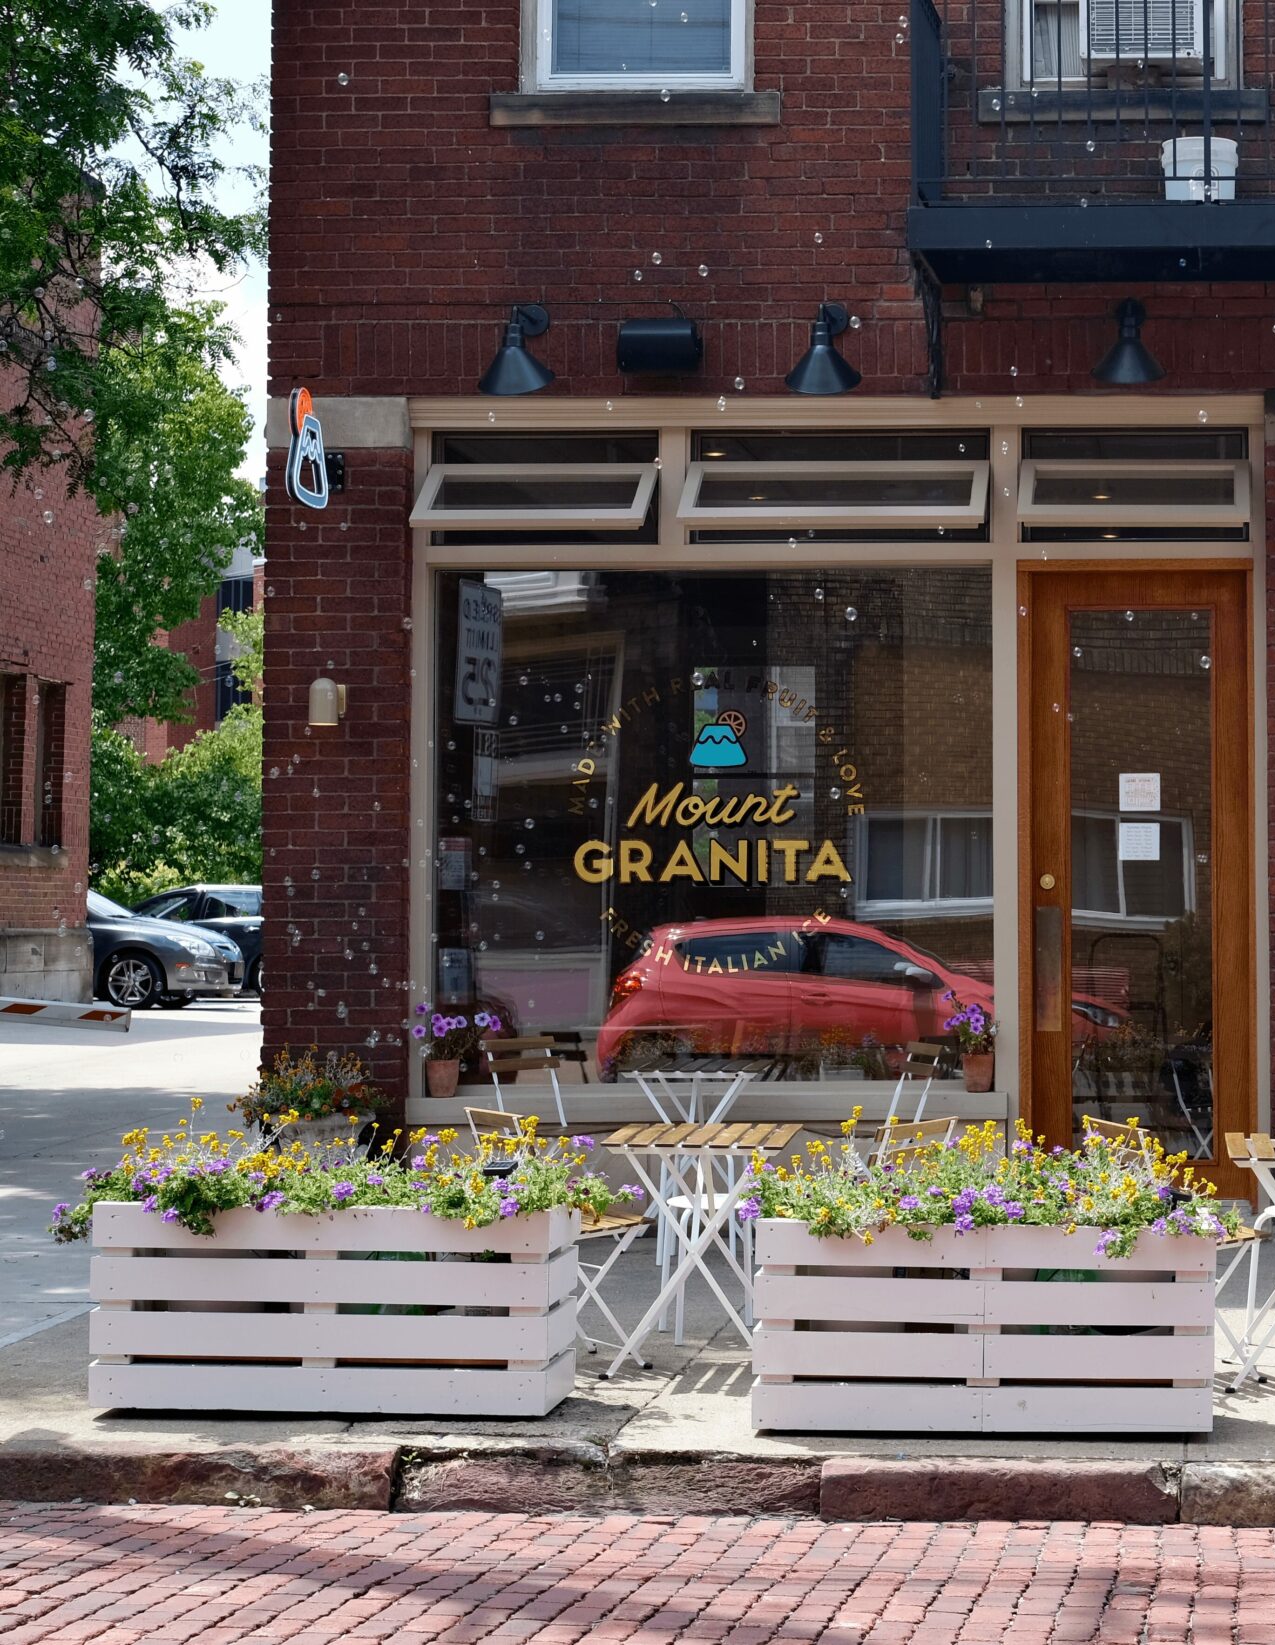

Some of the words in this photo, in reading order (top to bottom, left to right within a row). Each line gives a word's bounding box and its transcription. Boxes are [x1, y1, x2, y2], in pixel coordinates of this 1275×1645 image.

[600, 687, 661, 736] WITH
[746, 676, 818, 723] FRUIT
[818, 726, 835, 744] &
[832, 748, 865, 816] LOVE
[626, 782, 801, 829] Mount
[573, 839, 852, 884] GRANITA
[600, 907, 673, 966] FRESH
[683, 941, 788, 974] ITALIAN
[792, 907, 832, 946] ICE
